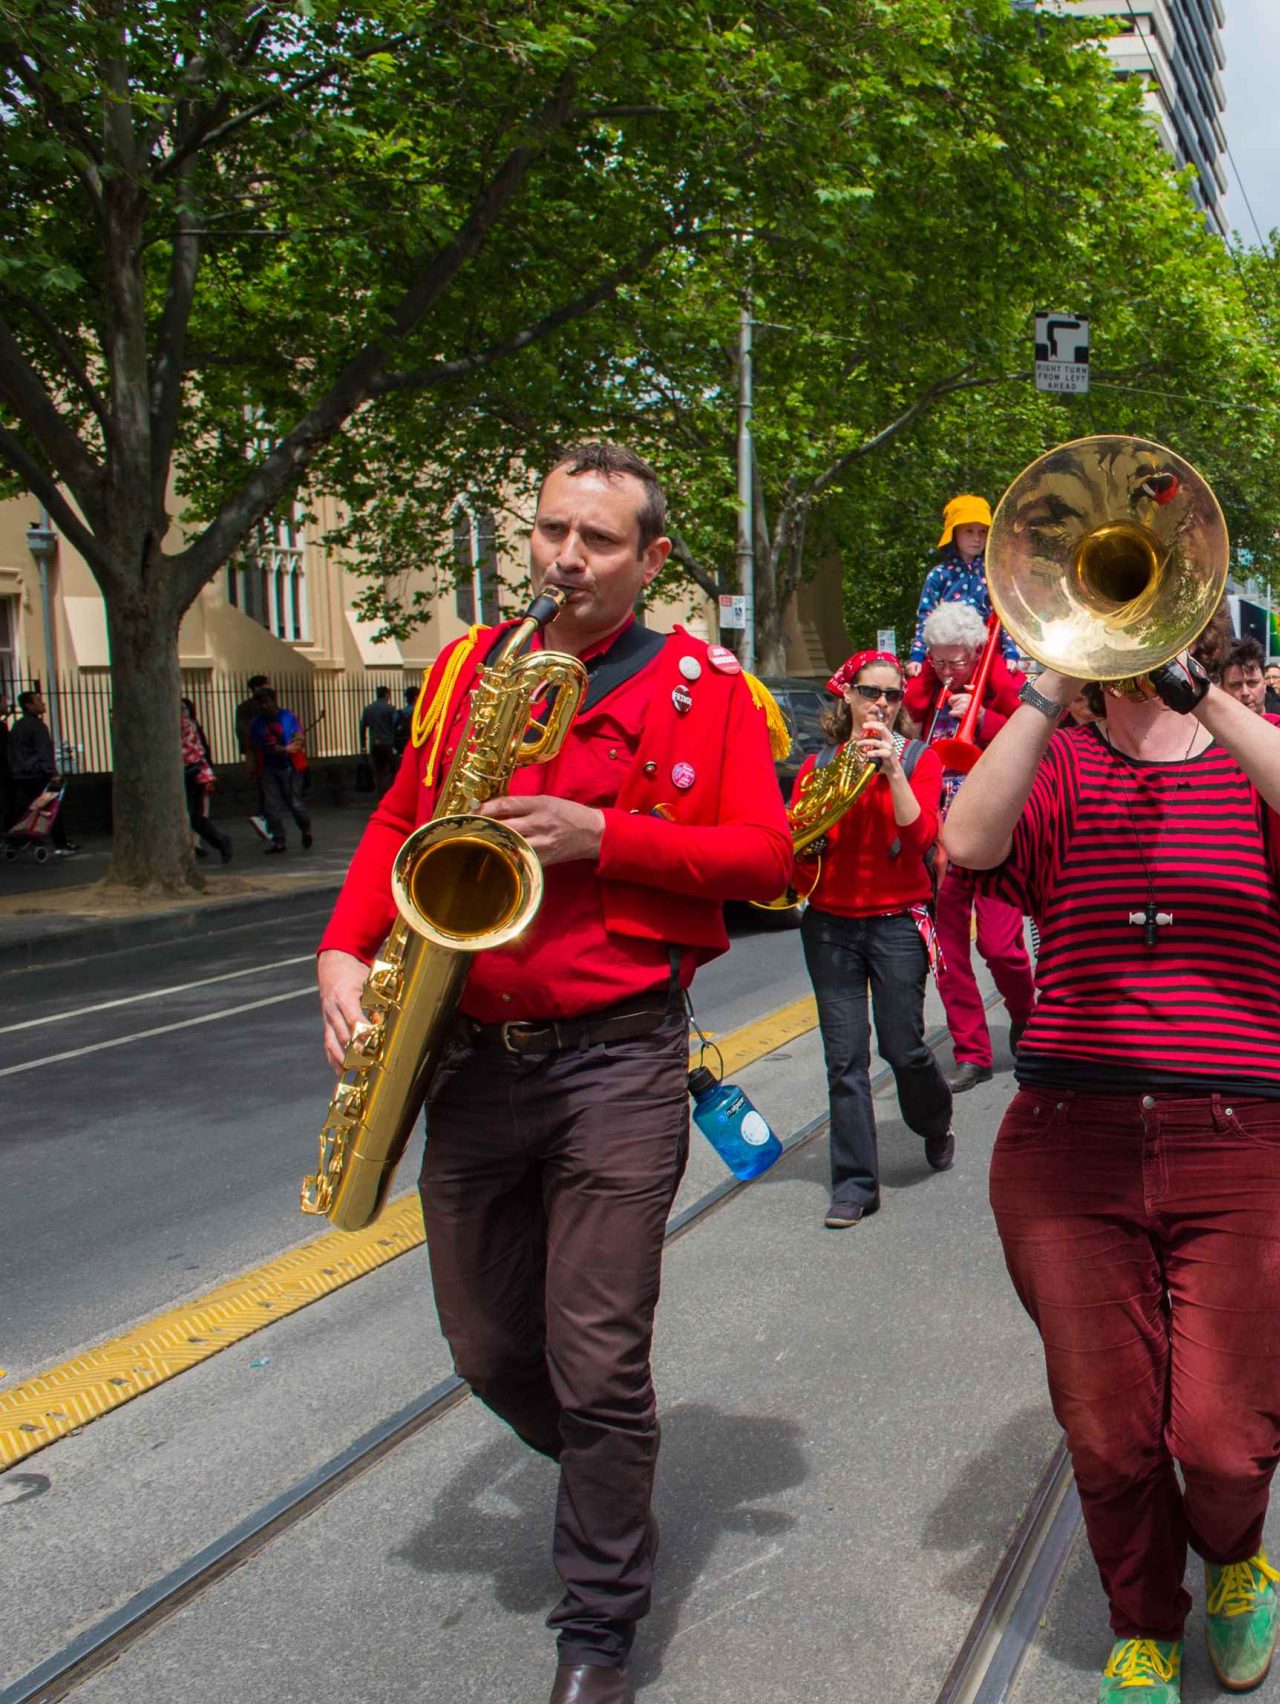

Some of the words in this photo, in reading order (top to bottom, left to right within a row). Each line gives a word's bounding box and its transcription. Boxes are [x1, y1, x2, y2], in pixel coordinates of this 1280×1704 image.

[1037, 364, 1061, 372] RIGHT
[1065, 366, 1087, 374] TURN
[1039, 372, 1060, 380] FROM
[1065, 374, 1086, 382] LEFT
[1048, 382, 1077, 390] AHEAD
